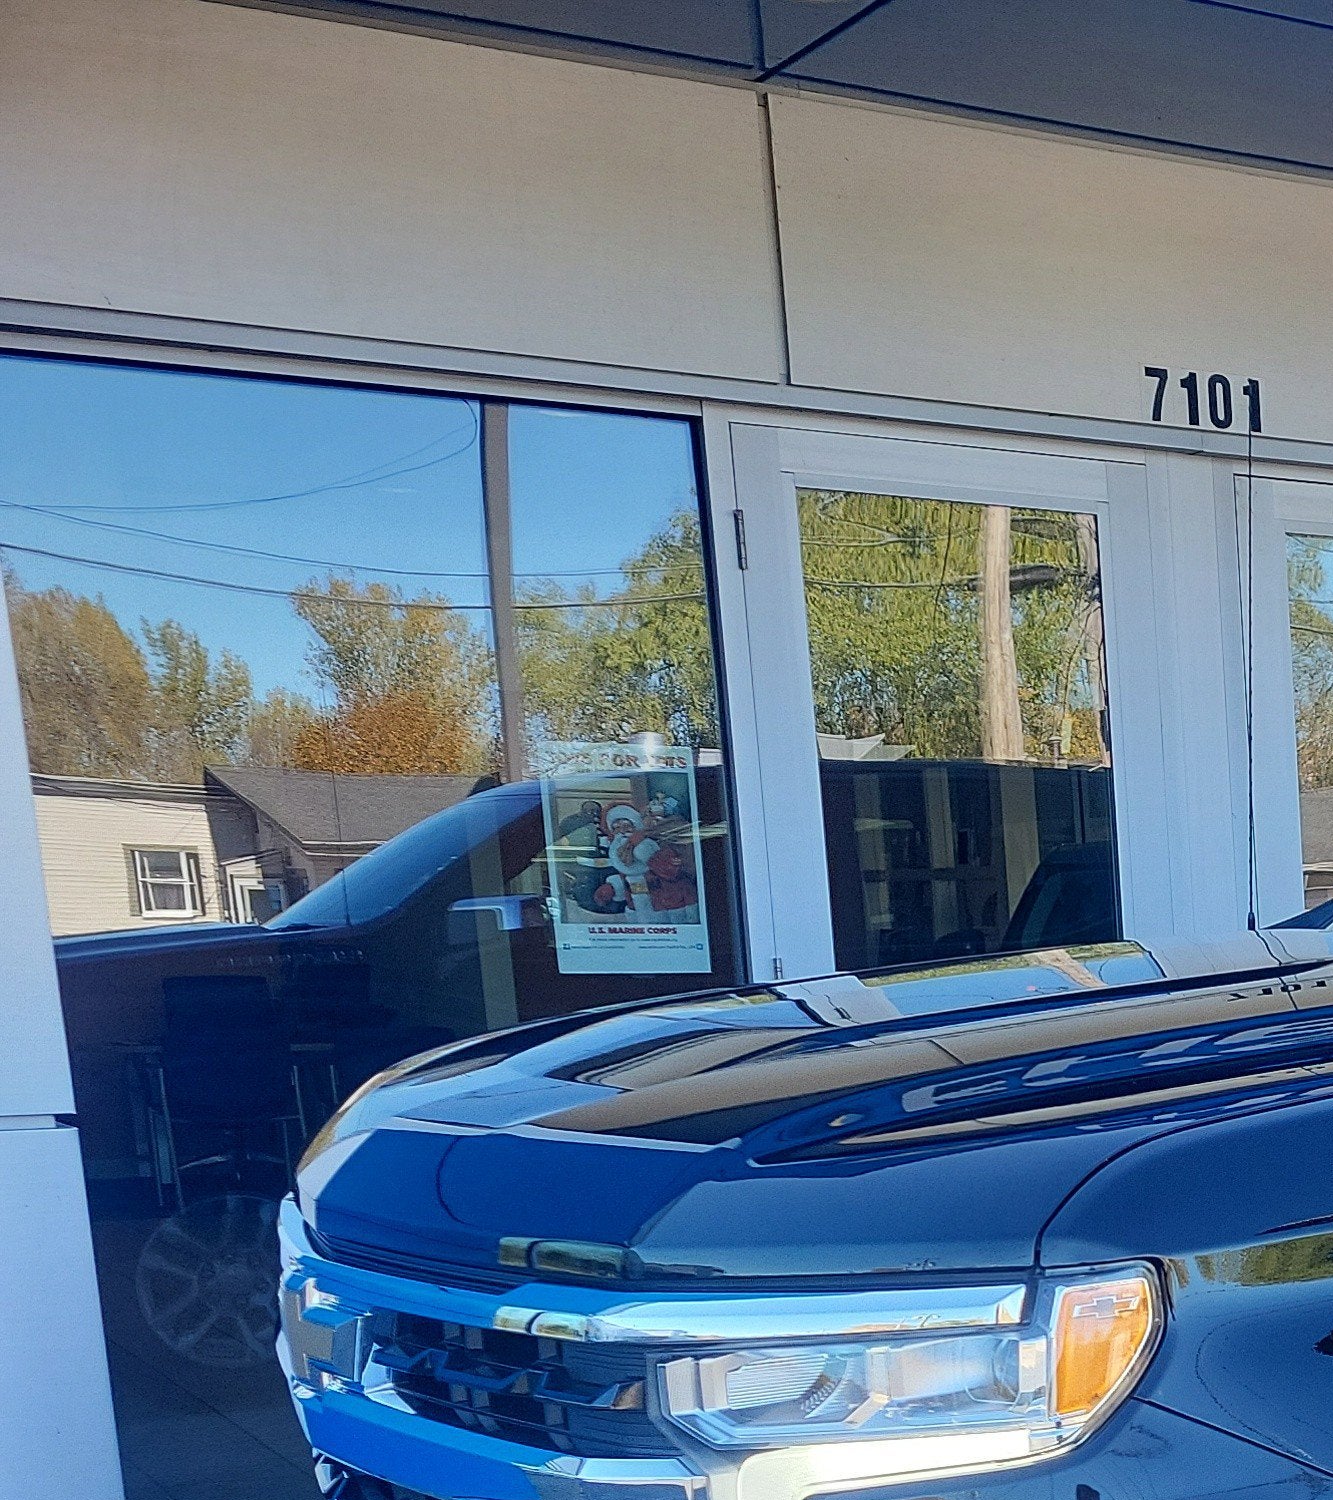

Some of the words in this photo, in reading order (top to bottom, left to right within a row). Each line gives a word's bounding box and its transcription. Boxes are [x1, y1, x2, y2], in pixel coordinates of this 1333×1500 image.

[1143, 366, 1262, 433] 7101
[608, 926, 645, 935] MARINE
[647, 926, 678, 935] CORPS
